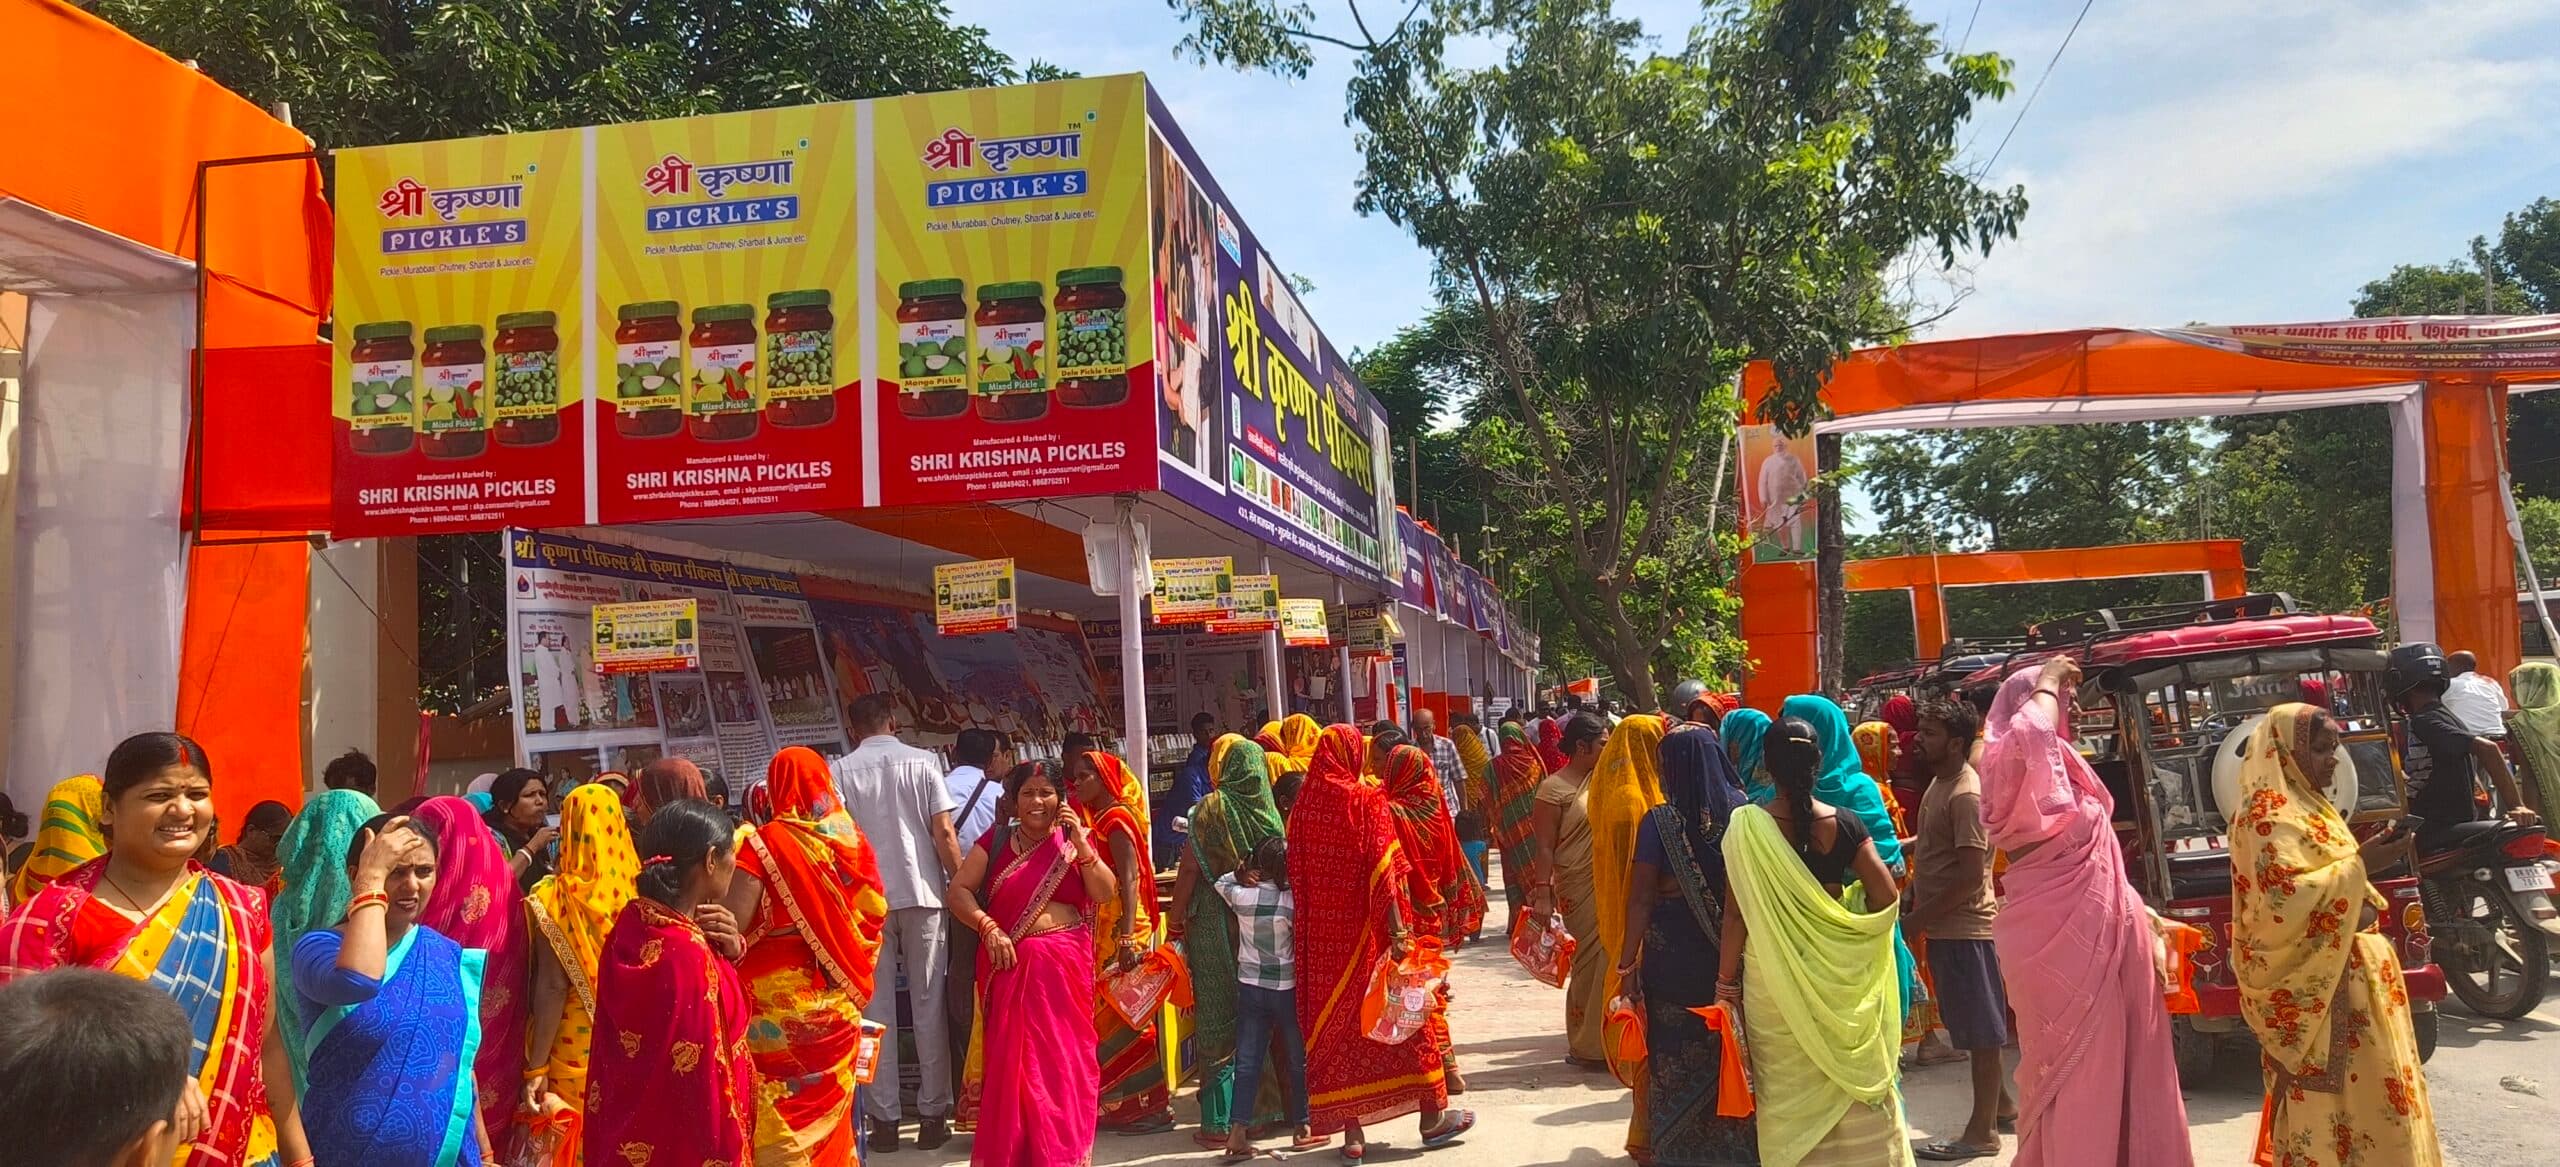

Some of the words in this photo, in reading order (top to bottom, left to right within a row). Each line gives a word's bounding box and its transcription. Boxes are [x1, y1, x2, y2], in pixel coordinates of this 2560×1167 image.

[1068, 122, 1081, 130] TM
[923, 129, 975, 170] श्री
[980, 134, 1080, 172] कृष्णा
[645, 156, 693, 195] श्री
[697, 161, 793, 197] कृष्णा
[380, 178, 426, 217] श्री
[431, 185, 522, 220] कृष्णा
[936, 175, 1078, 204] PICKLE'S
[656, 201, 790, 228] PICKLE'S
[1024, 212, 1053, 223] Sharbat
[1054, 212, 1060, 220] &
[1062, 210, 1081, 221] Juice
[390, 224, 518, 250] PICKLE'S
[739, 238, 765, 248] Sharbat
[774, 235, 792, 245] Juice
[2421, 322, 2469, 344] पशुधन
[1079, 368, 1102, 376] Pickle
[988, 382, 1012, 391] Mixed
[1014, 381, 1038, 389] Pickle
[1226, 279, 1263, 401] श्री
[1265, 337, 1321, 453] कृष्णा
[1320, 382, 1375, 497] पीकल्स
[701, 402, 725, 410] Mixed
[726, 401, 748, 409] Pickle
[1022, 434, 1048, 442] Marked
[733, 454, 757, 462] Marked
[910, 454, 953, 472] SHRI
[959, 448, 1042, 469] KRISHNA
[1047, 442, 1126, 463] PICKLES
[462, 471, 484, 479] Marked
[627, 471, 667, 489] SHRI
[673, 467, 752, 486] KRISHNA
[757, 461, 832, 481] PICKLES
[359, 488, 398, 505] SHRI
[404, 484, 479, 502] KRISHNA
[484, 479, 556, 498] PICKLES
[967, 483, 987, 491] Phone
[409, 516, 429, 524] Phone
[515, 535, 536, 559] श्री
[541, 542, 581, 567] कृष्णा
[582, 543, 629, 572] पीकल्स
[630, 550, 648, 575] श्री
[650, 559, 684, 580] कृष्णा
[684, 559, 724, 584] पीकल्स
